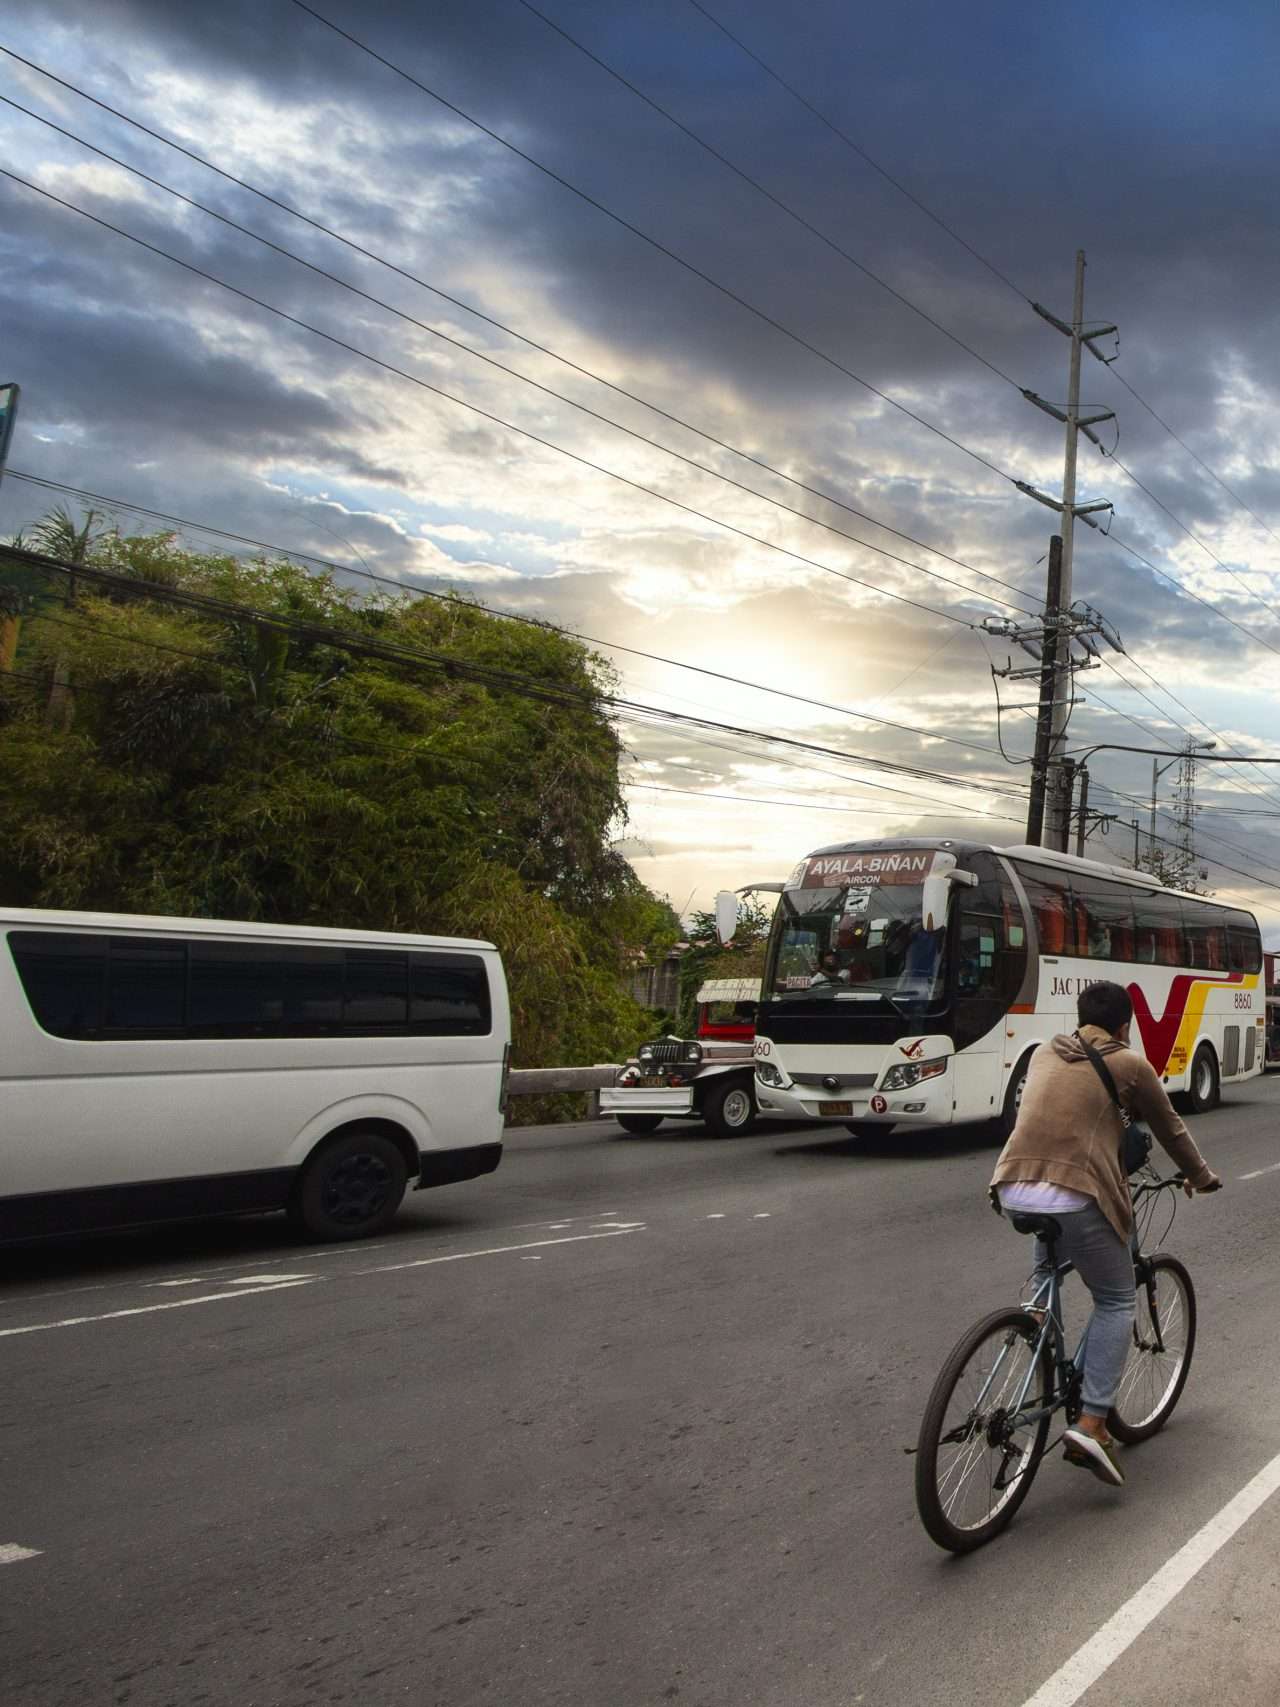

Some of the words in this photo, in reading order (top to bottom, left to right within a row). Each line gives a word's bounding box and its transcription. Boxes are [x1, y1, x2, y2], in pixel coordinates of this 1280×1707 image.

[811, 854, 926, 875] AYALA-BIÑAN
[845, 875, 880, 884] AIRCON
[1051, 977, 1073, 996] JAC
[1234, 993, 1252, 1009] 8860
